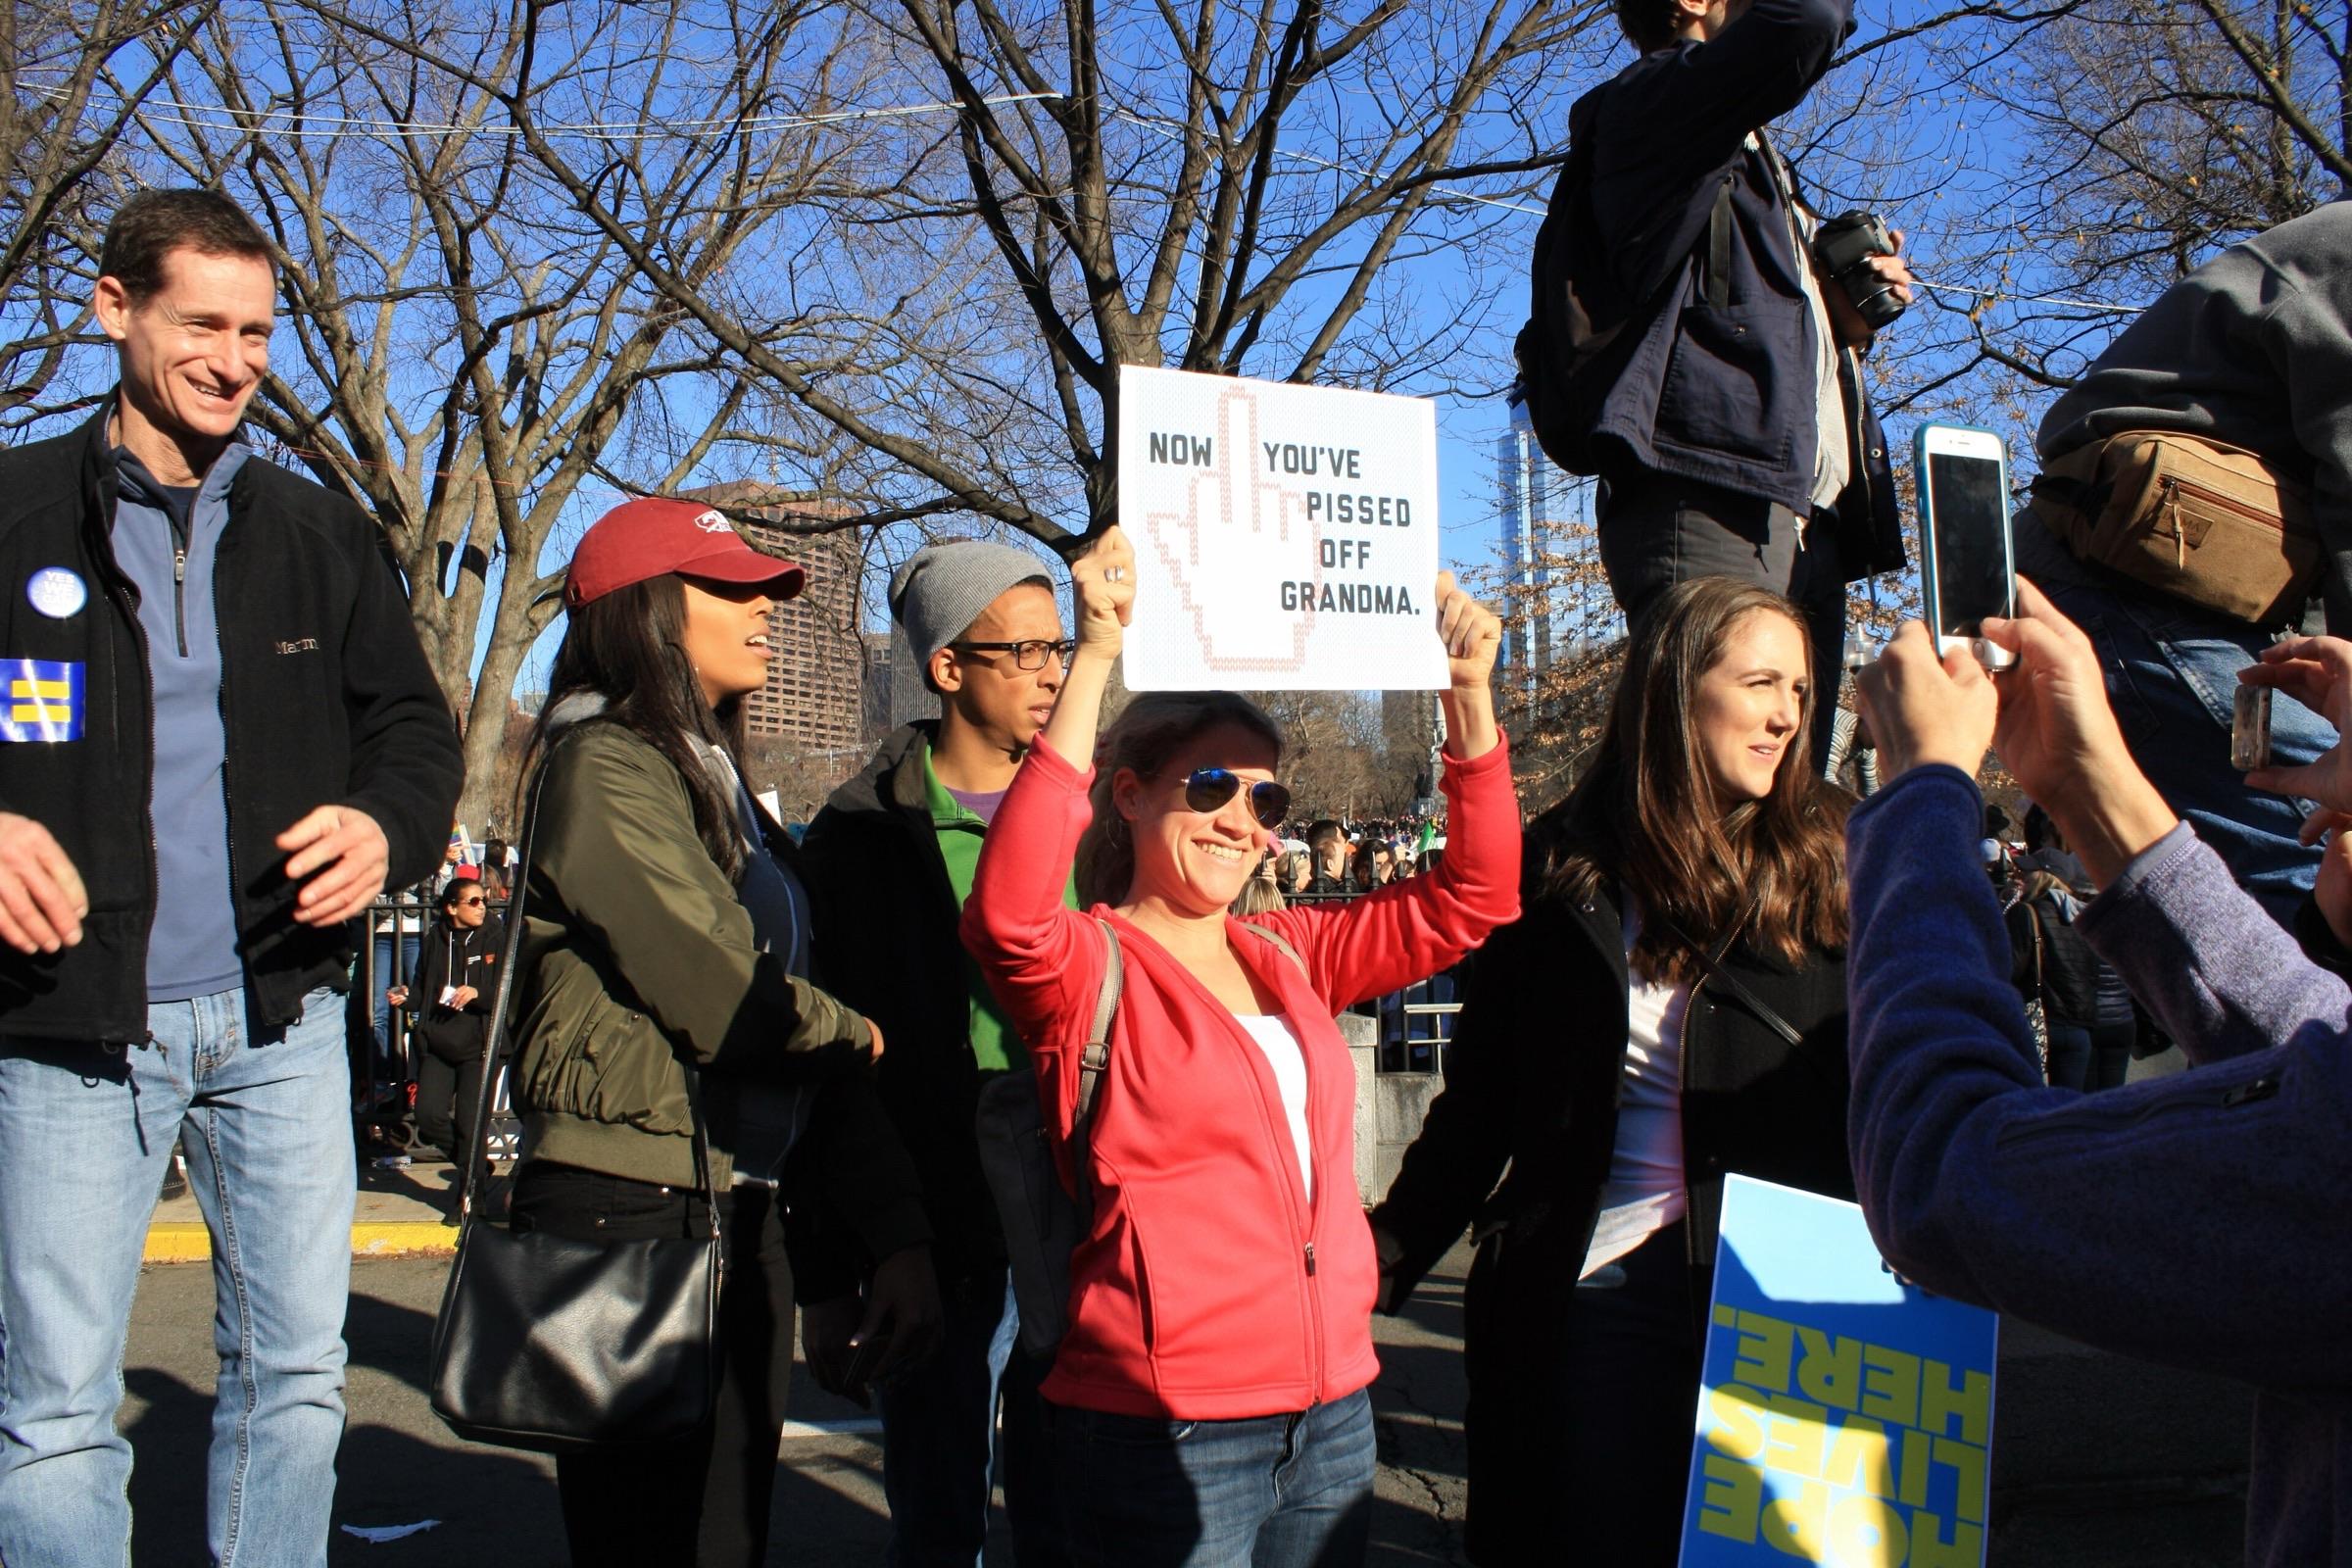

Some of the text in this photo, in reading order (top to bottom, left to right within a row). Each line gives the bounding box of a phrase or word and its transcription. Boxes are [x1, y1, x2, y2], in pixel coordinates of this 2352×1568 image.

[1151, 433, 1359, 478] NOW YOU'VE
[1307, 492, 1409, 526] PISSED
[1321, 539, 1370, 568] OFF
[1282, 581, 1419, 614] GRANDMA.
[1713, 1303, 1990, 1445] HERE.
[1708, 1382, 1988, 1523] LIVES
[1697, 1452, 1983, 1568] HOPE
